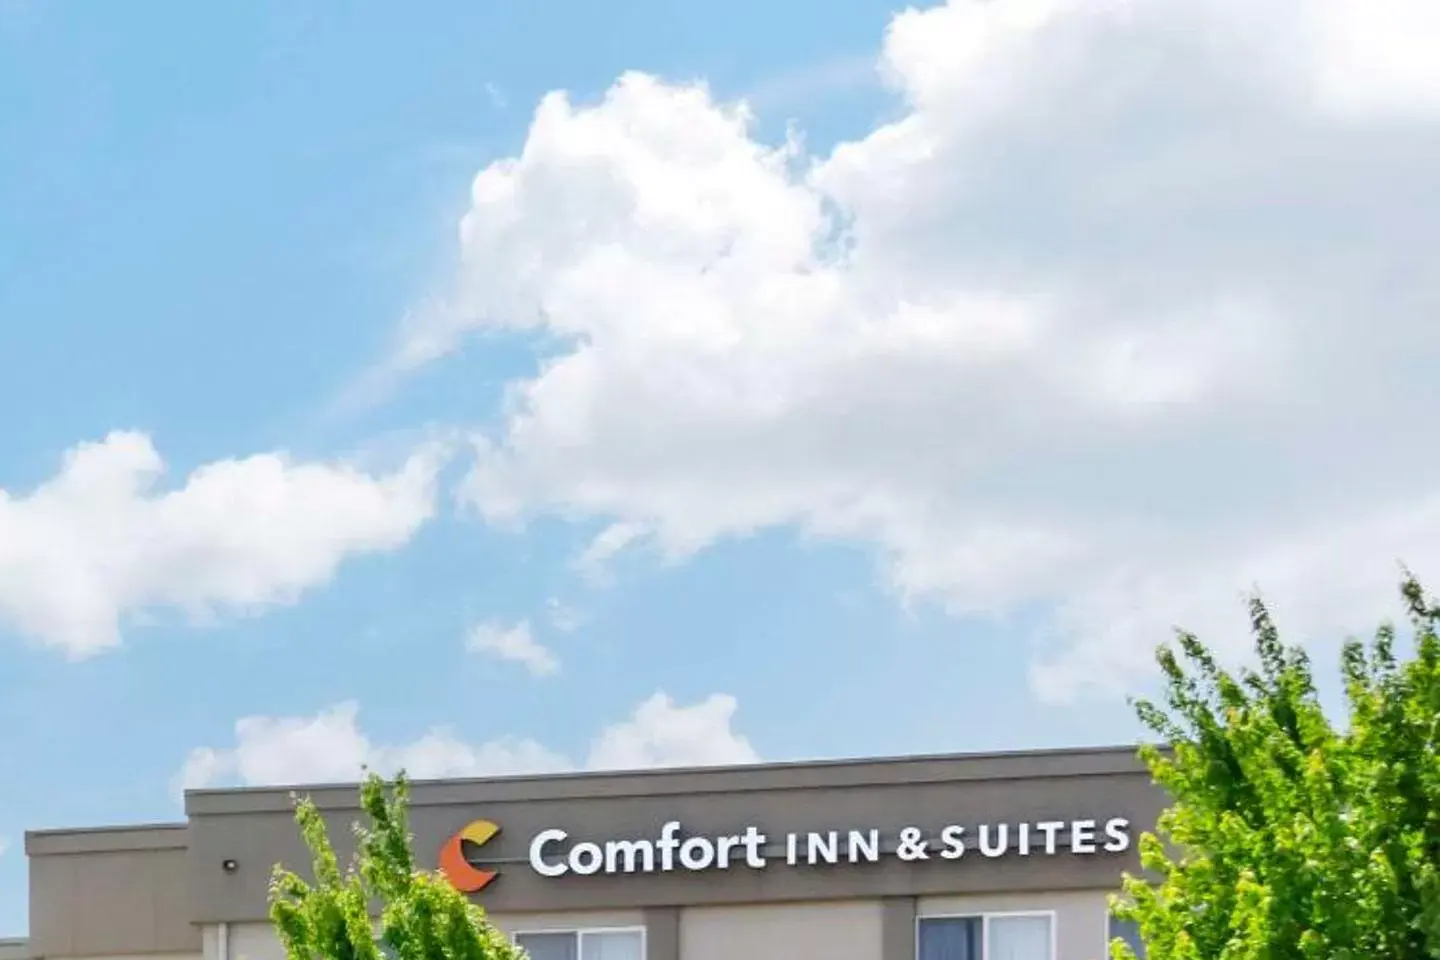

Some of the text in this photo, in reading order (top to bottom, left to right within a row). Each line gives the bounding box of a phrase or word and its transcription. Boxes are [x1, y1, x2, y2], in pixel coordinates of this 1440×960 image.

[528, 817, 1131, 877] Comfort INN & SUITES
